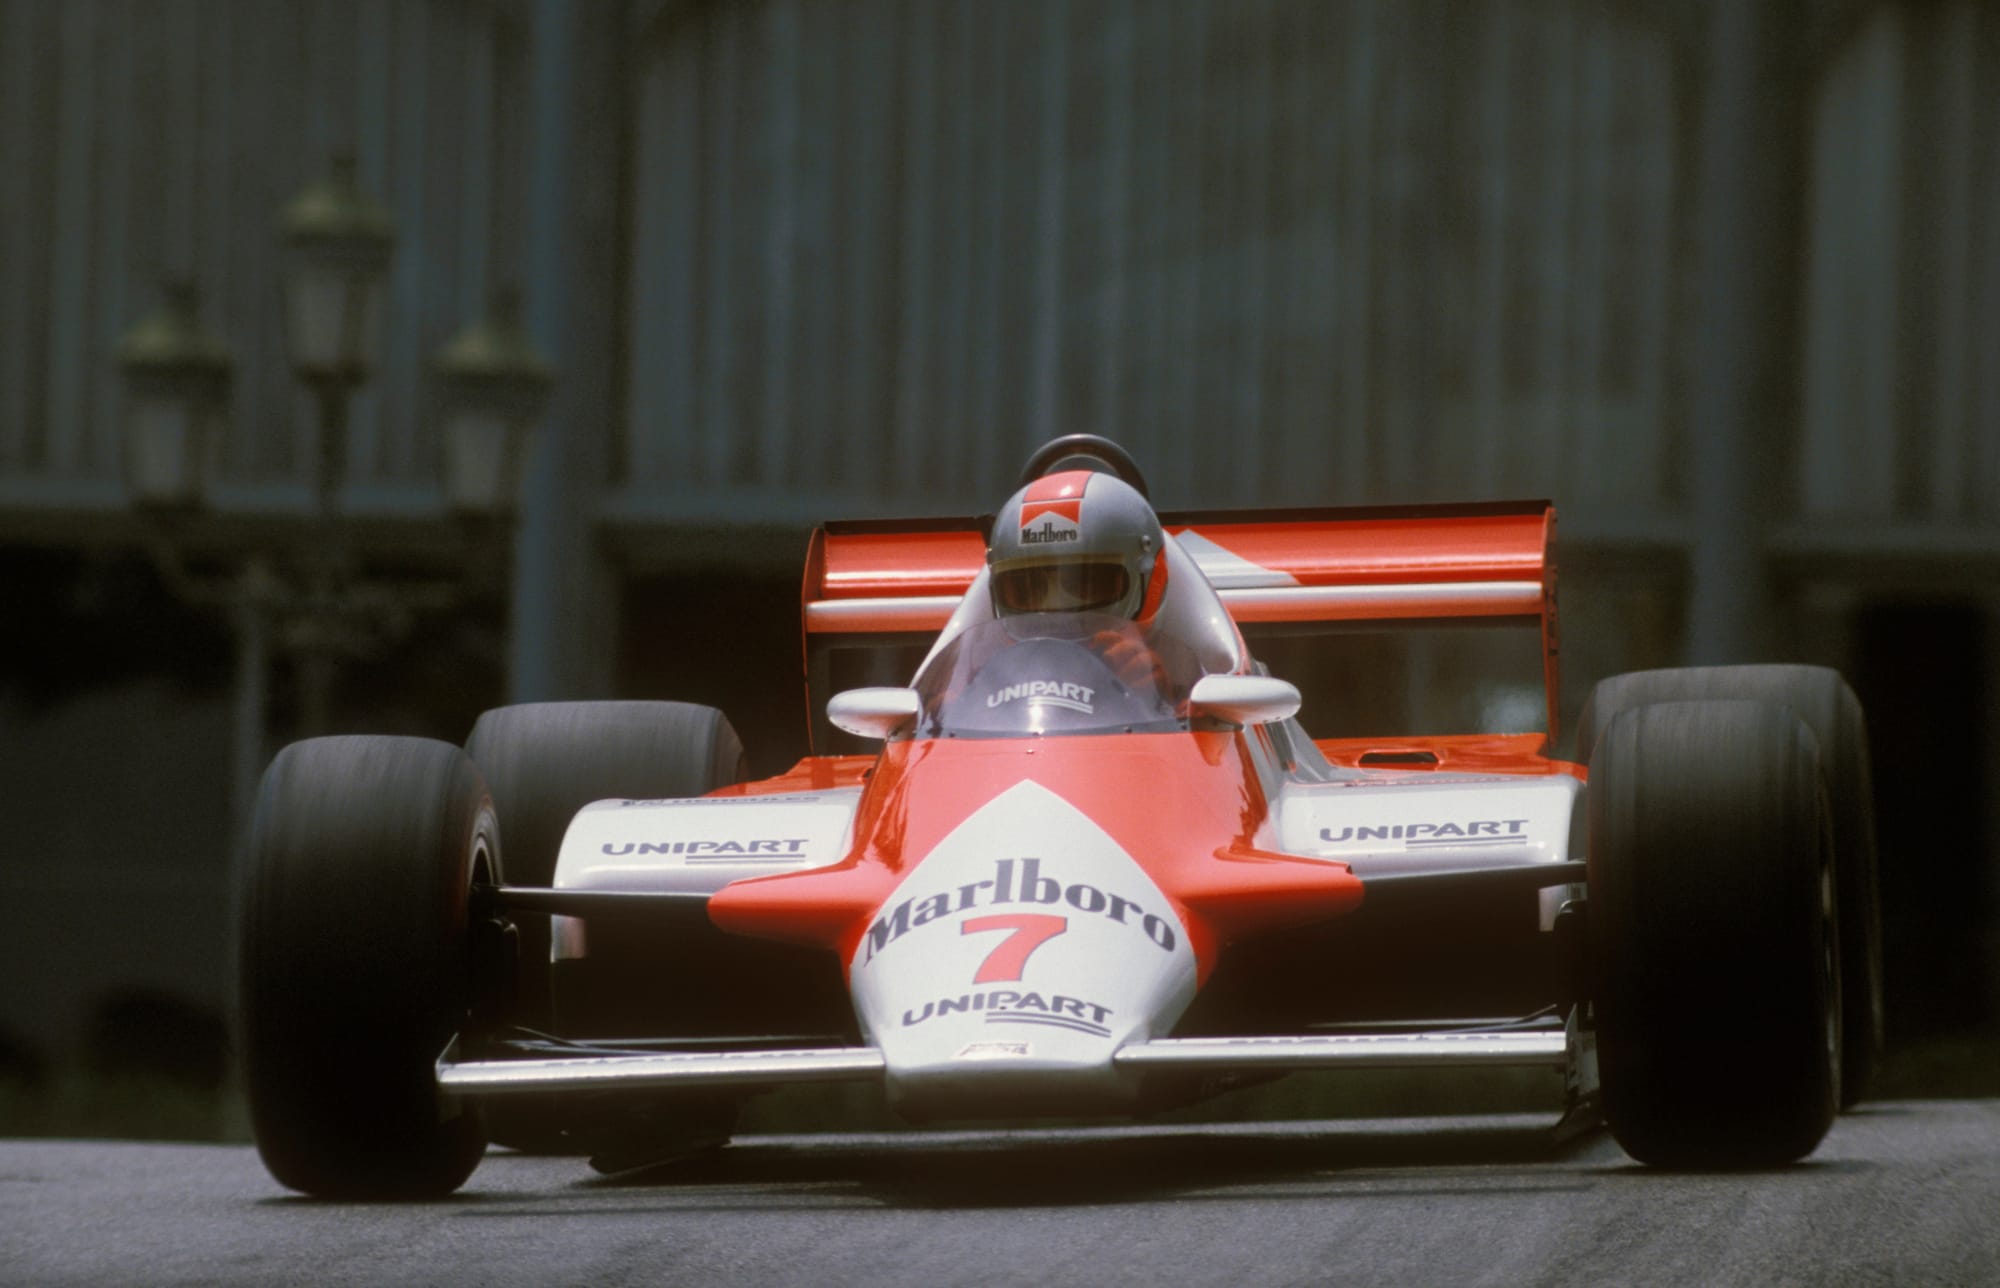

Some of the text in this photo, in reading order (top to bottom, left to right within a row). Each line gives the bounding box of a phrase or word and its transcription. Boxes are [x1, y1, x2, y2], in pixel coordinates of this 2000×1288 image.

[1021, 522, 1077, 544] Marlboro
[987, 681, 1095, 708] UNIPART
[1320, 819, 1529, 842] UNIPART
[602, 839, 810, 855] UNIPART
[863, 858, 1176, 968] Marlboro
[961, 913, 1068, 984] 7
[902, 991, 1114, 1027] UNIPART
